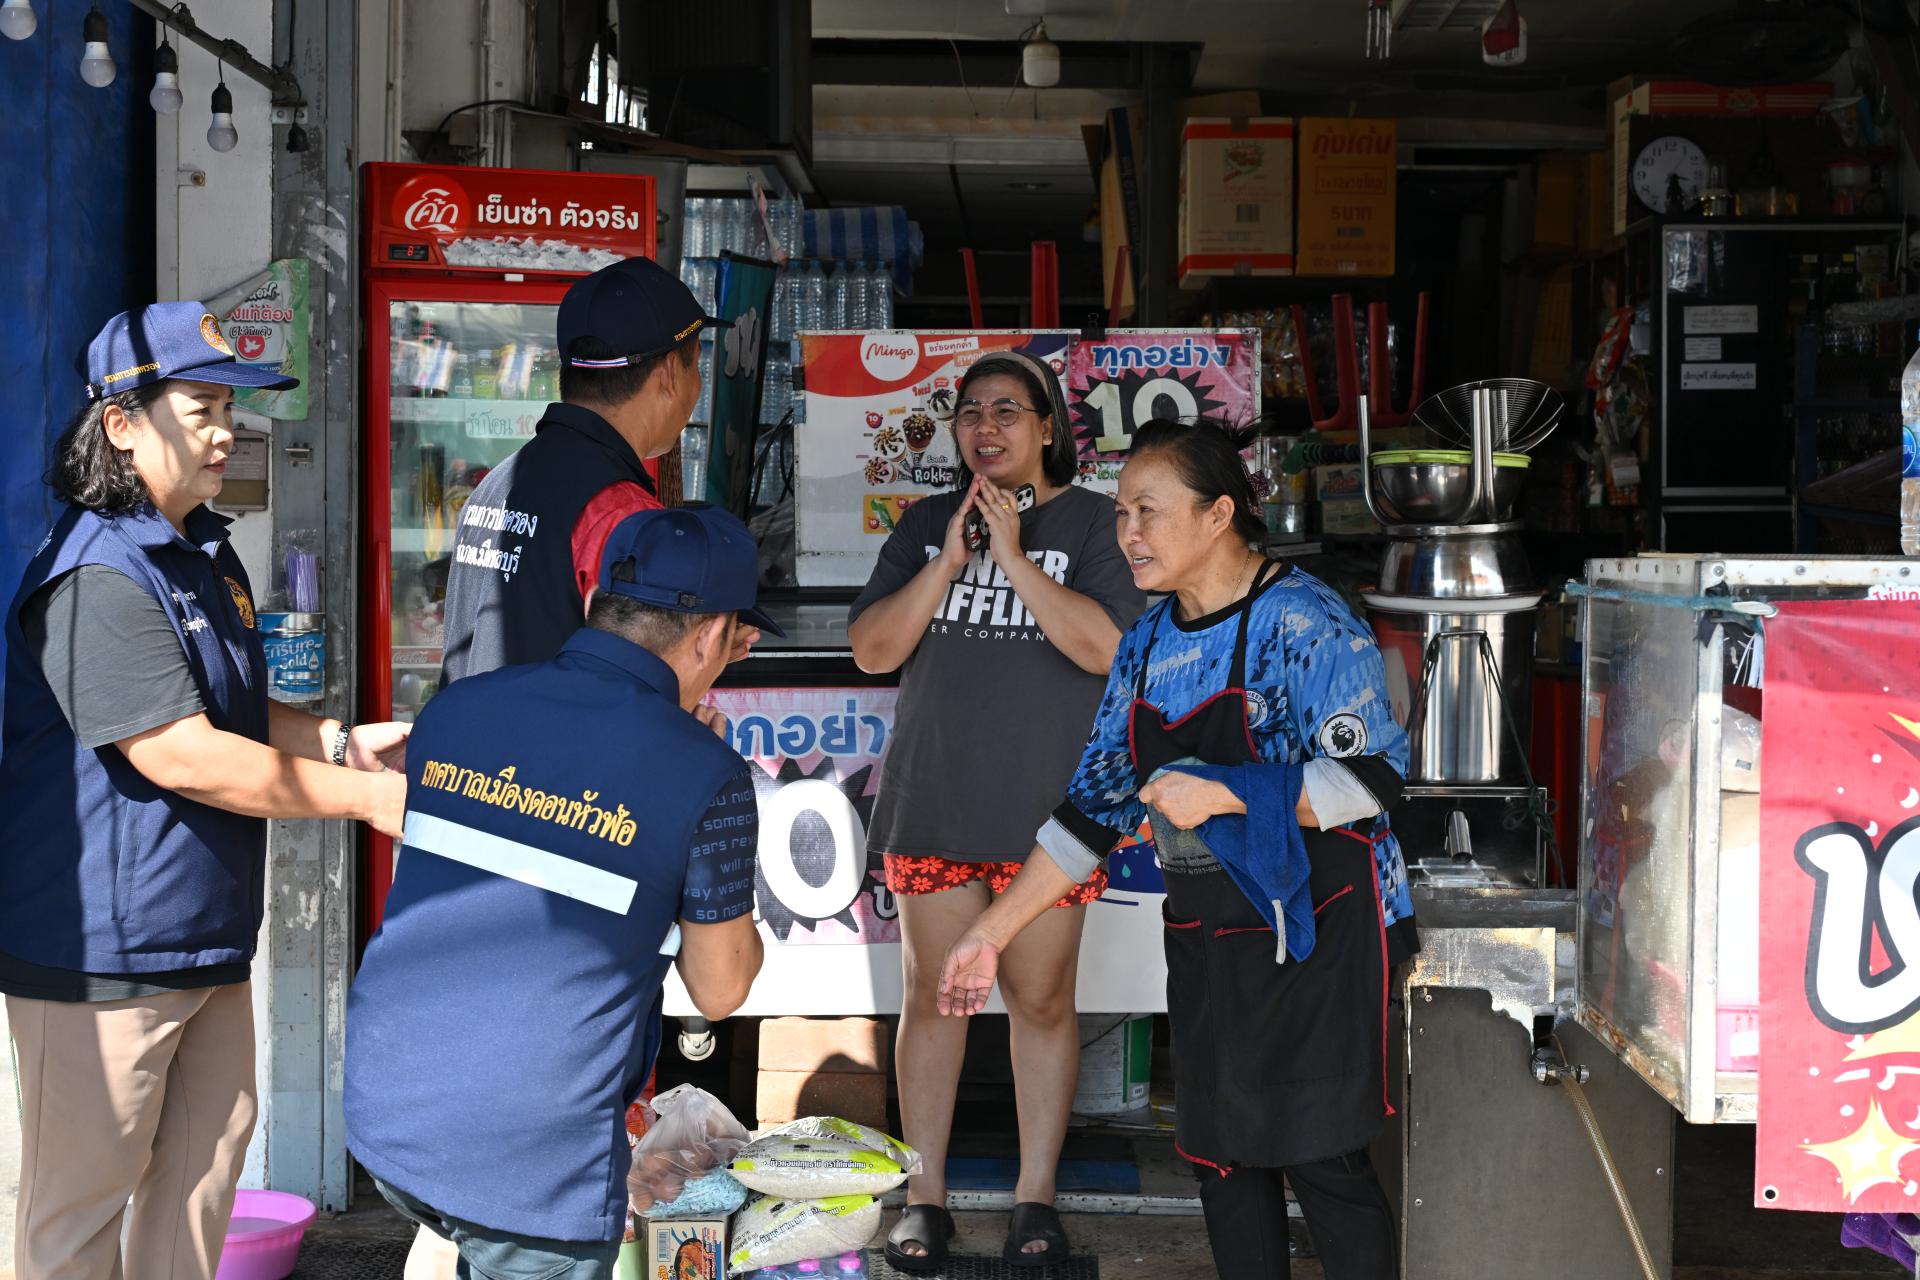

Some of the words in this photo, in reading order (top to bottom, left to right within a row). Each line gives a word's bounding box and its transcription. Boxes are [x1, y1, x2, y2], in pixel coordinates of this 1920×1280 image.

[477, 194, 552, 226] เย็นซ่า
[559, 201, 640, 231] ตัวจริง
[866, 342, 914, 361] Mingo
[1091, 336, 1233, 379] ทุกอย่าง
[420, 760, 638, 847] เทศบาลเมืองดอนหัวฬ่อ
